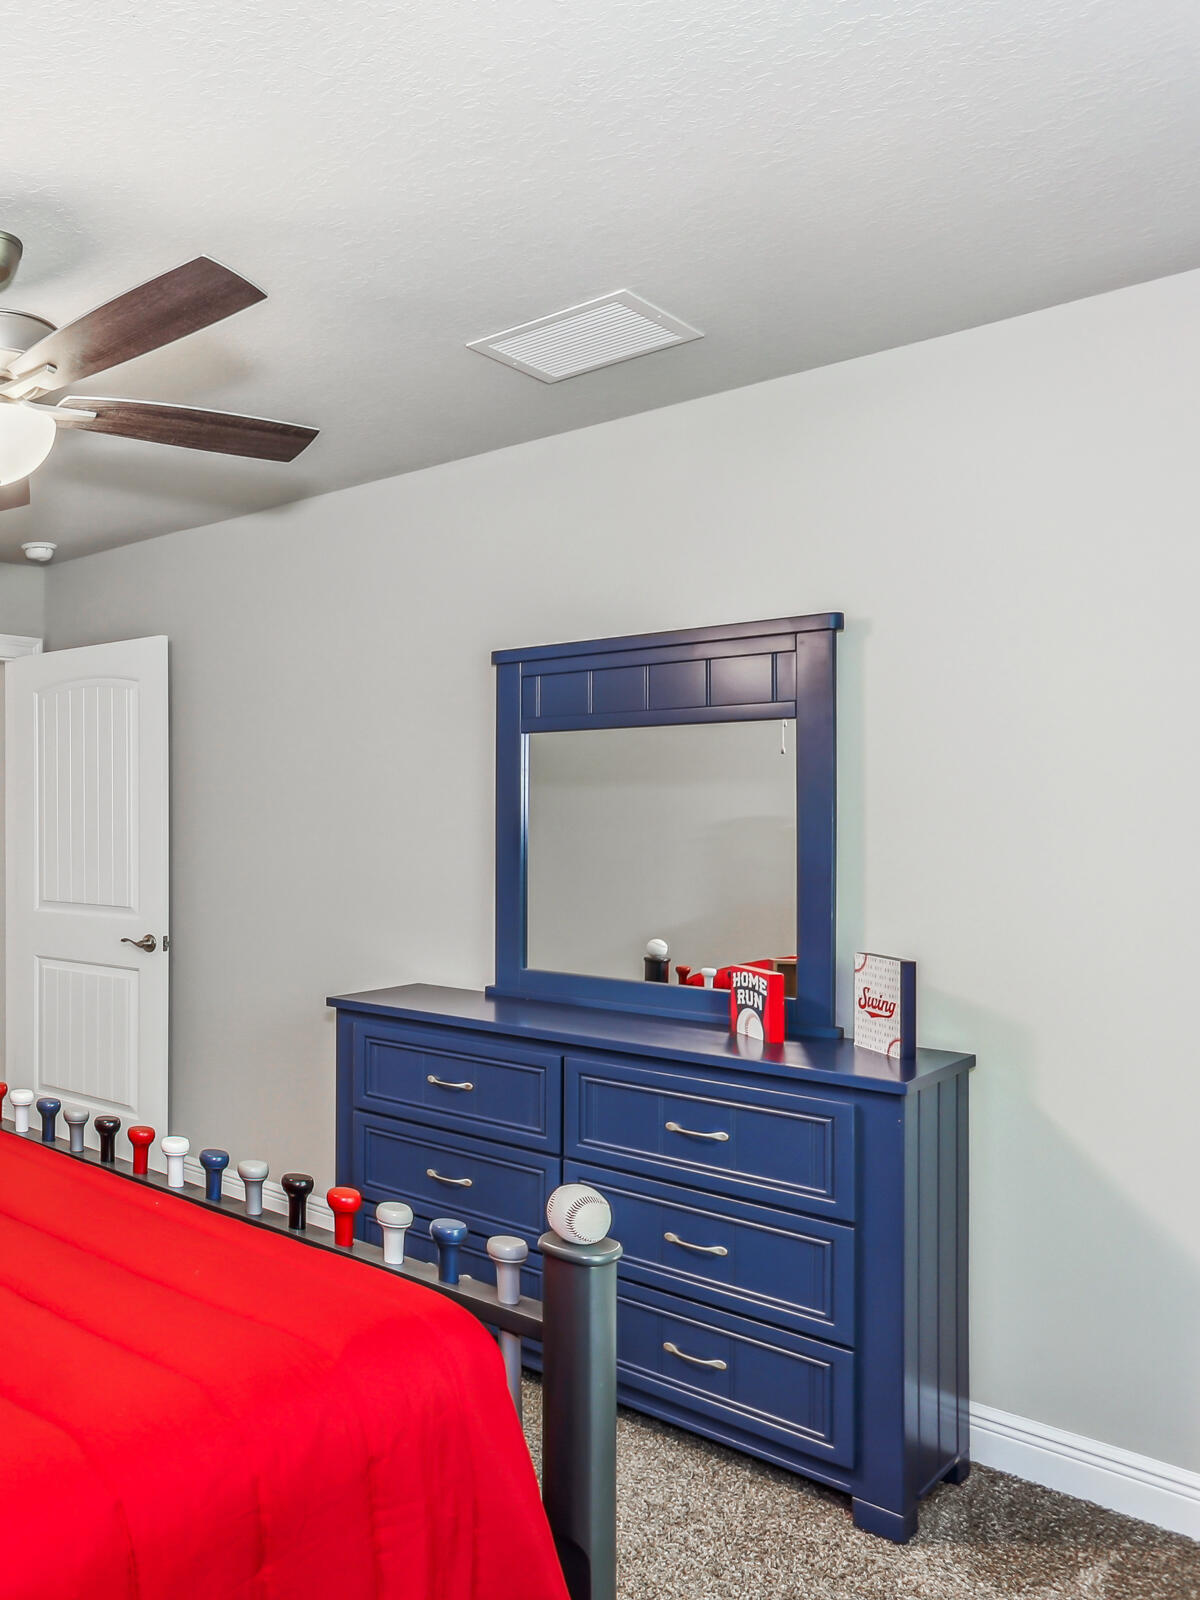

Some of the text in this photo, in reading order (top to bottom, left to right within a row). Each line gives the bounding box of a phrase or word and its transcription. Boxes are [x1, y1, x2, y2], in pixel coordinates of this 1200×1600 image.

[732, 971, 768, 996] HOME
[737, 989, 762, 1011] RUN
[858, 987, 896, 1018] Swing
